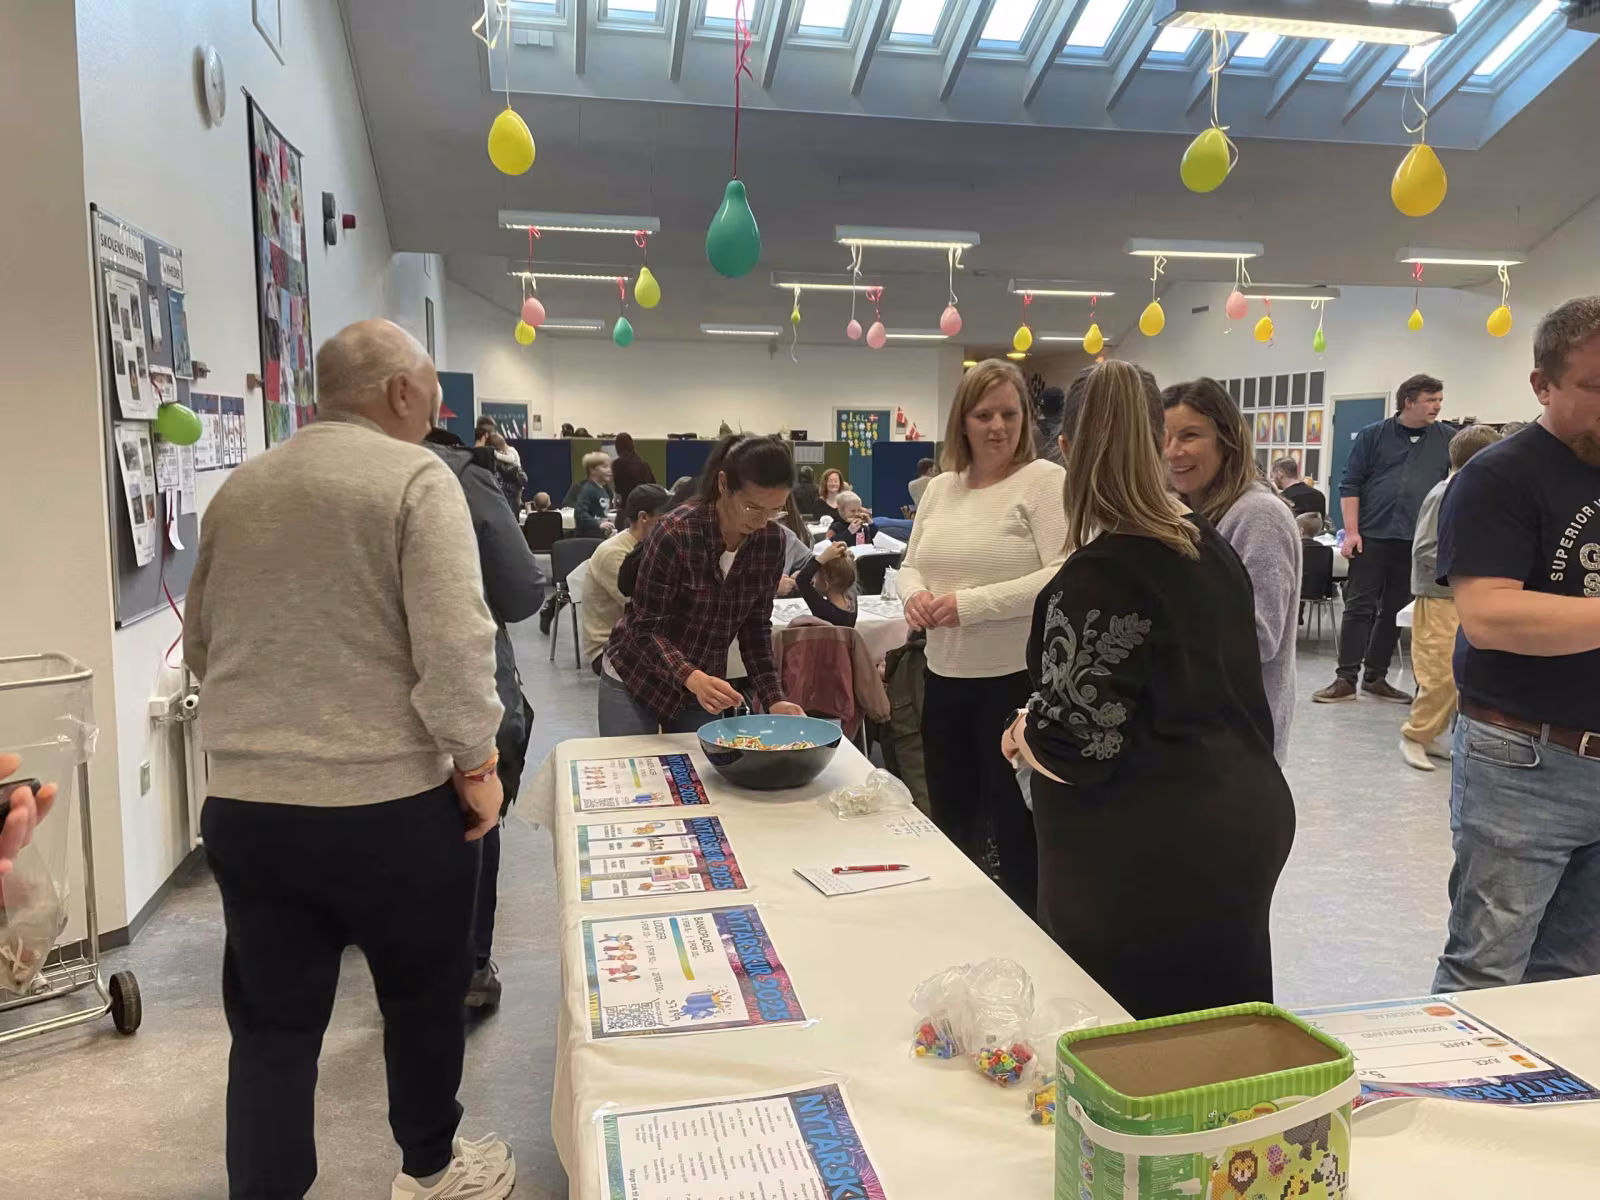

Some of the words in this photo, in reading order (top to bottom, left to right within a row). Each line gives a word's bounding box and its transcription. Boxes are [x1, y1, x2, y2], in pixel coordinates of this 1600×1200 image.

[100, 233, 124, 256] SKOLENS
[125, 244, 144, 265] VENNER
[1550, 506, 1595, 581] SUPERIOR
[680, 784, 700, 805] 2025
[708, 865, 734, 890] 2025
[653, 920, 666, 940] LODDER
[693, 917, 714, 953] BANKOPLADER
[726, 910, 772, 976] NYTÅRSKUR
[752, 978, 791, 1020] 2025
[1440, 1040, 1474, 1048] KAFFE
[1472, 1058, 1501, 1066] JUICE
